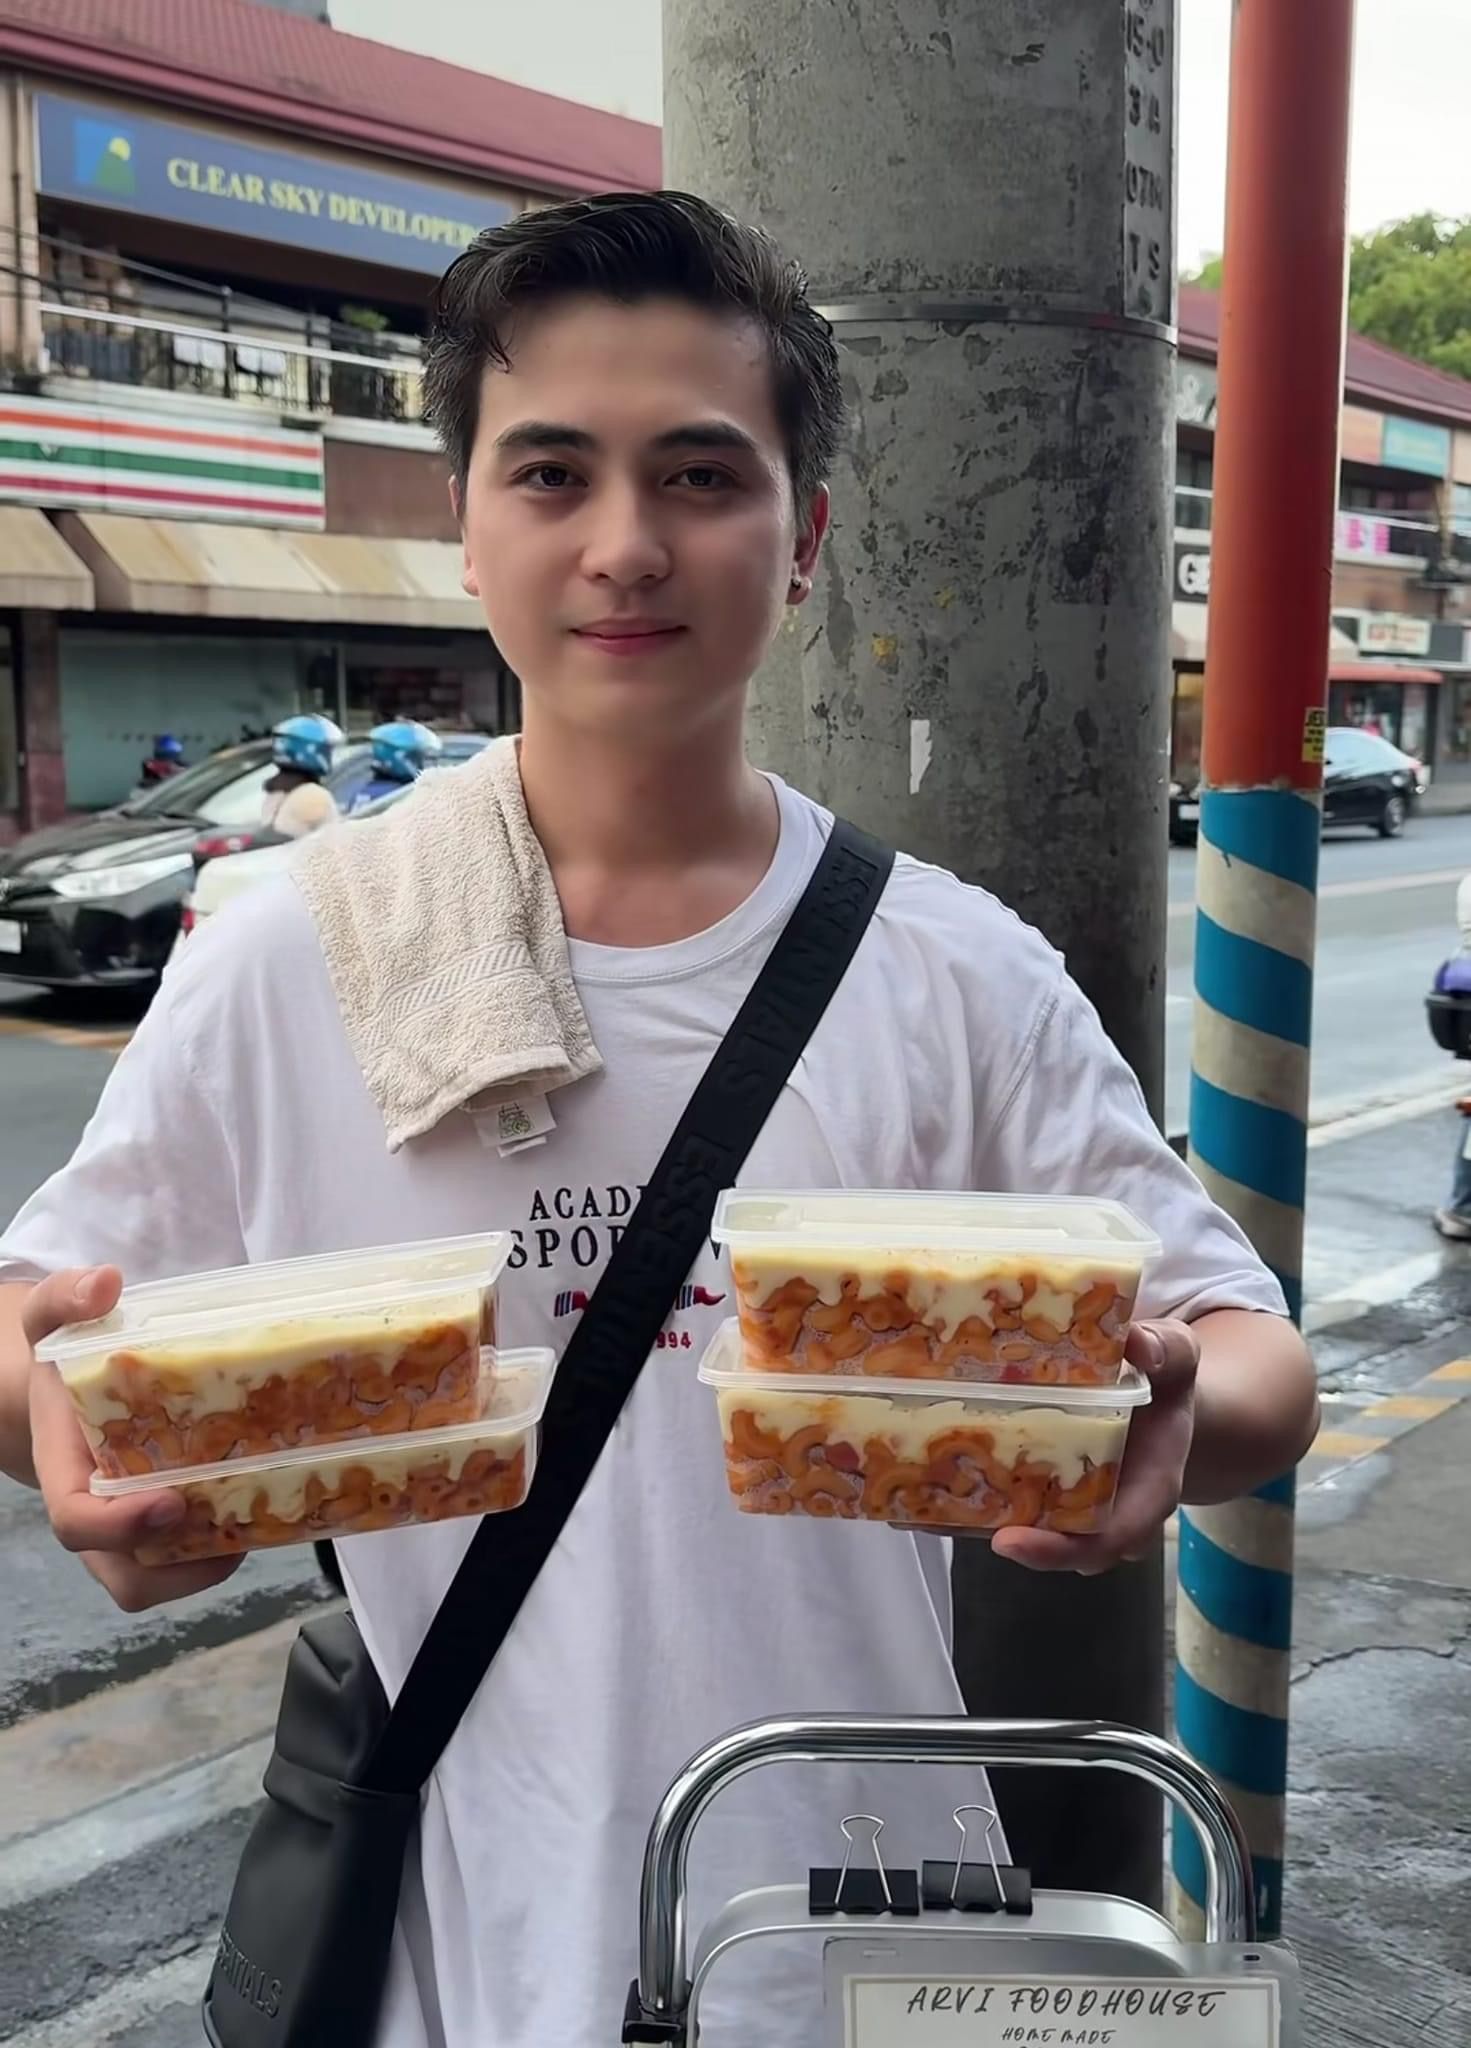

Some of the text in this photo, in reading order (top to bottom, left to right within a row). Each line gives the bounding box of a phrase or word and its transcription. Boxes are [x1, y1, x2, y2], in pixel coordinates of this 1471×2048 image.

[167, 158, 478, 248] CLEAR SKY DEVELOPER
[907, 1985, 995, 2014] ARVI
[1002, 2026, 1117, 2044] HOME MADE
